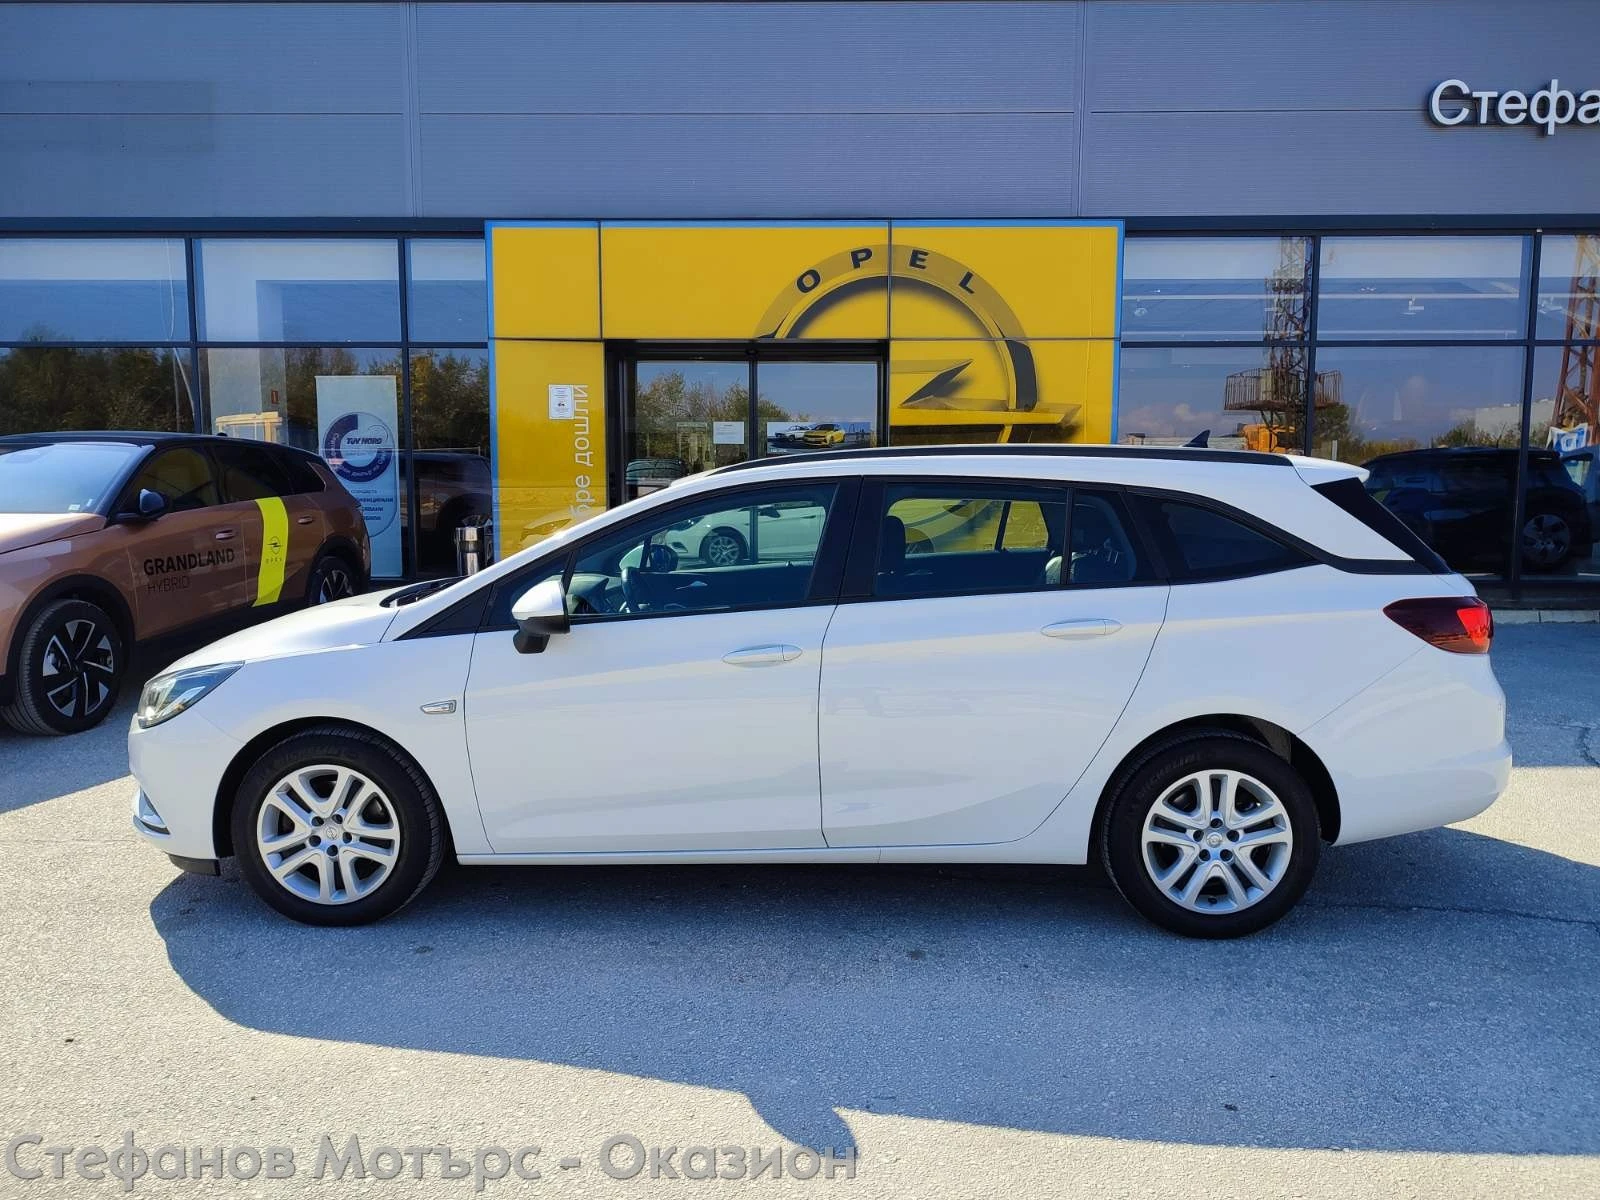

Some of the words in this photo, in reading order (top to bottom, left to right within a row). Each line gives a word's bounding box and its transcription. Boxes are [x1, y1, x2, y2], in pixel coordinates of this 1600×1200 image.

[1430, 79, 1600, 136] Стефа
[796, 247, 975, 294] OPEL
[574, 384, 594, 467] дошли
[569, 474, 596, 520] бре
[143, 548, 236, 576] GRANDLAND
[146, 575, 191, 593] HYBRID
